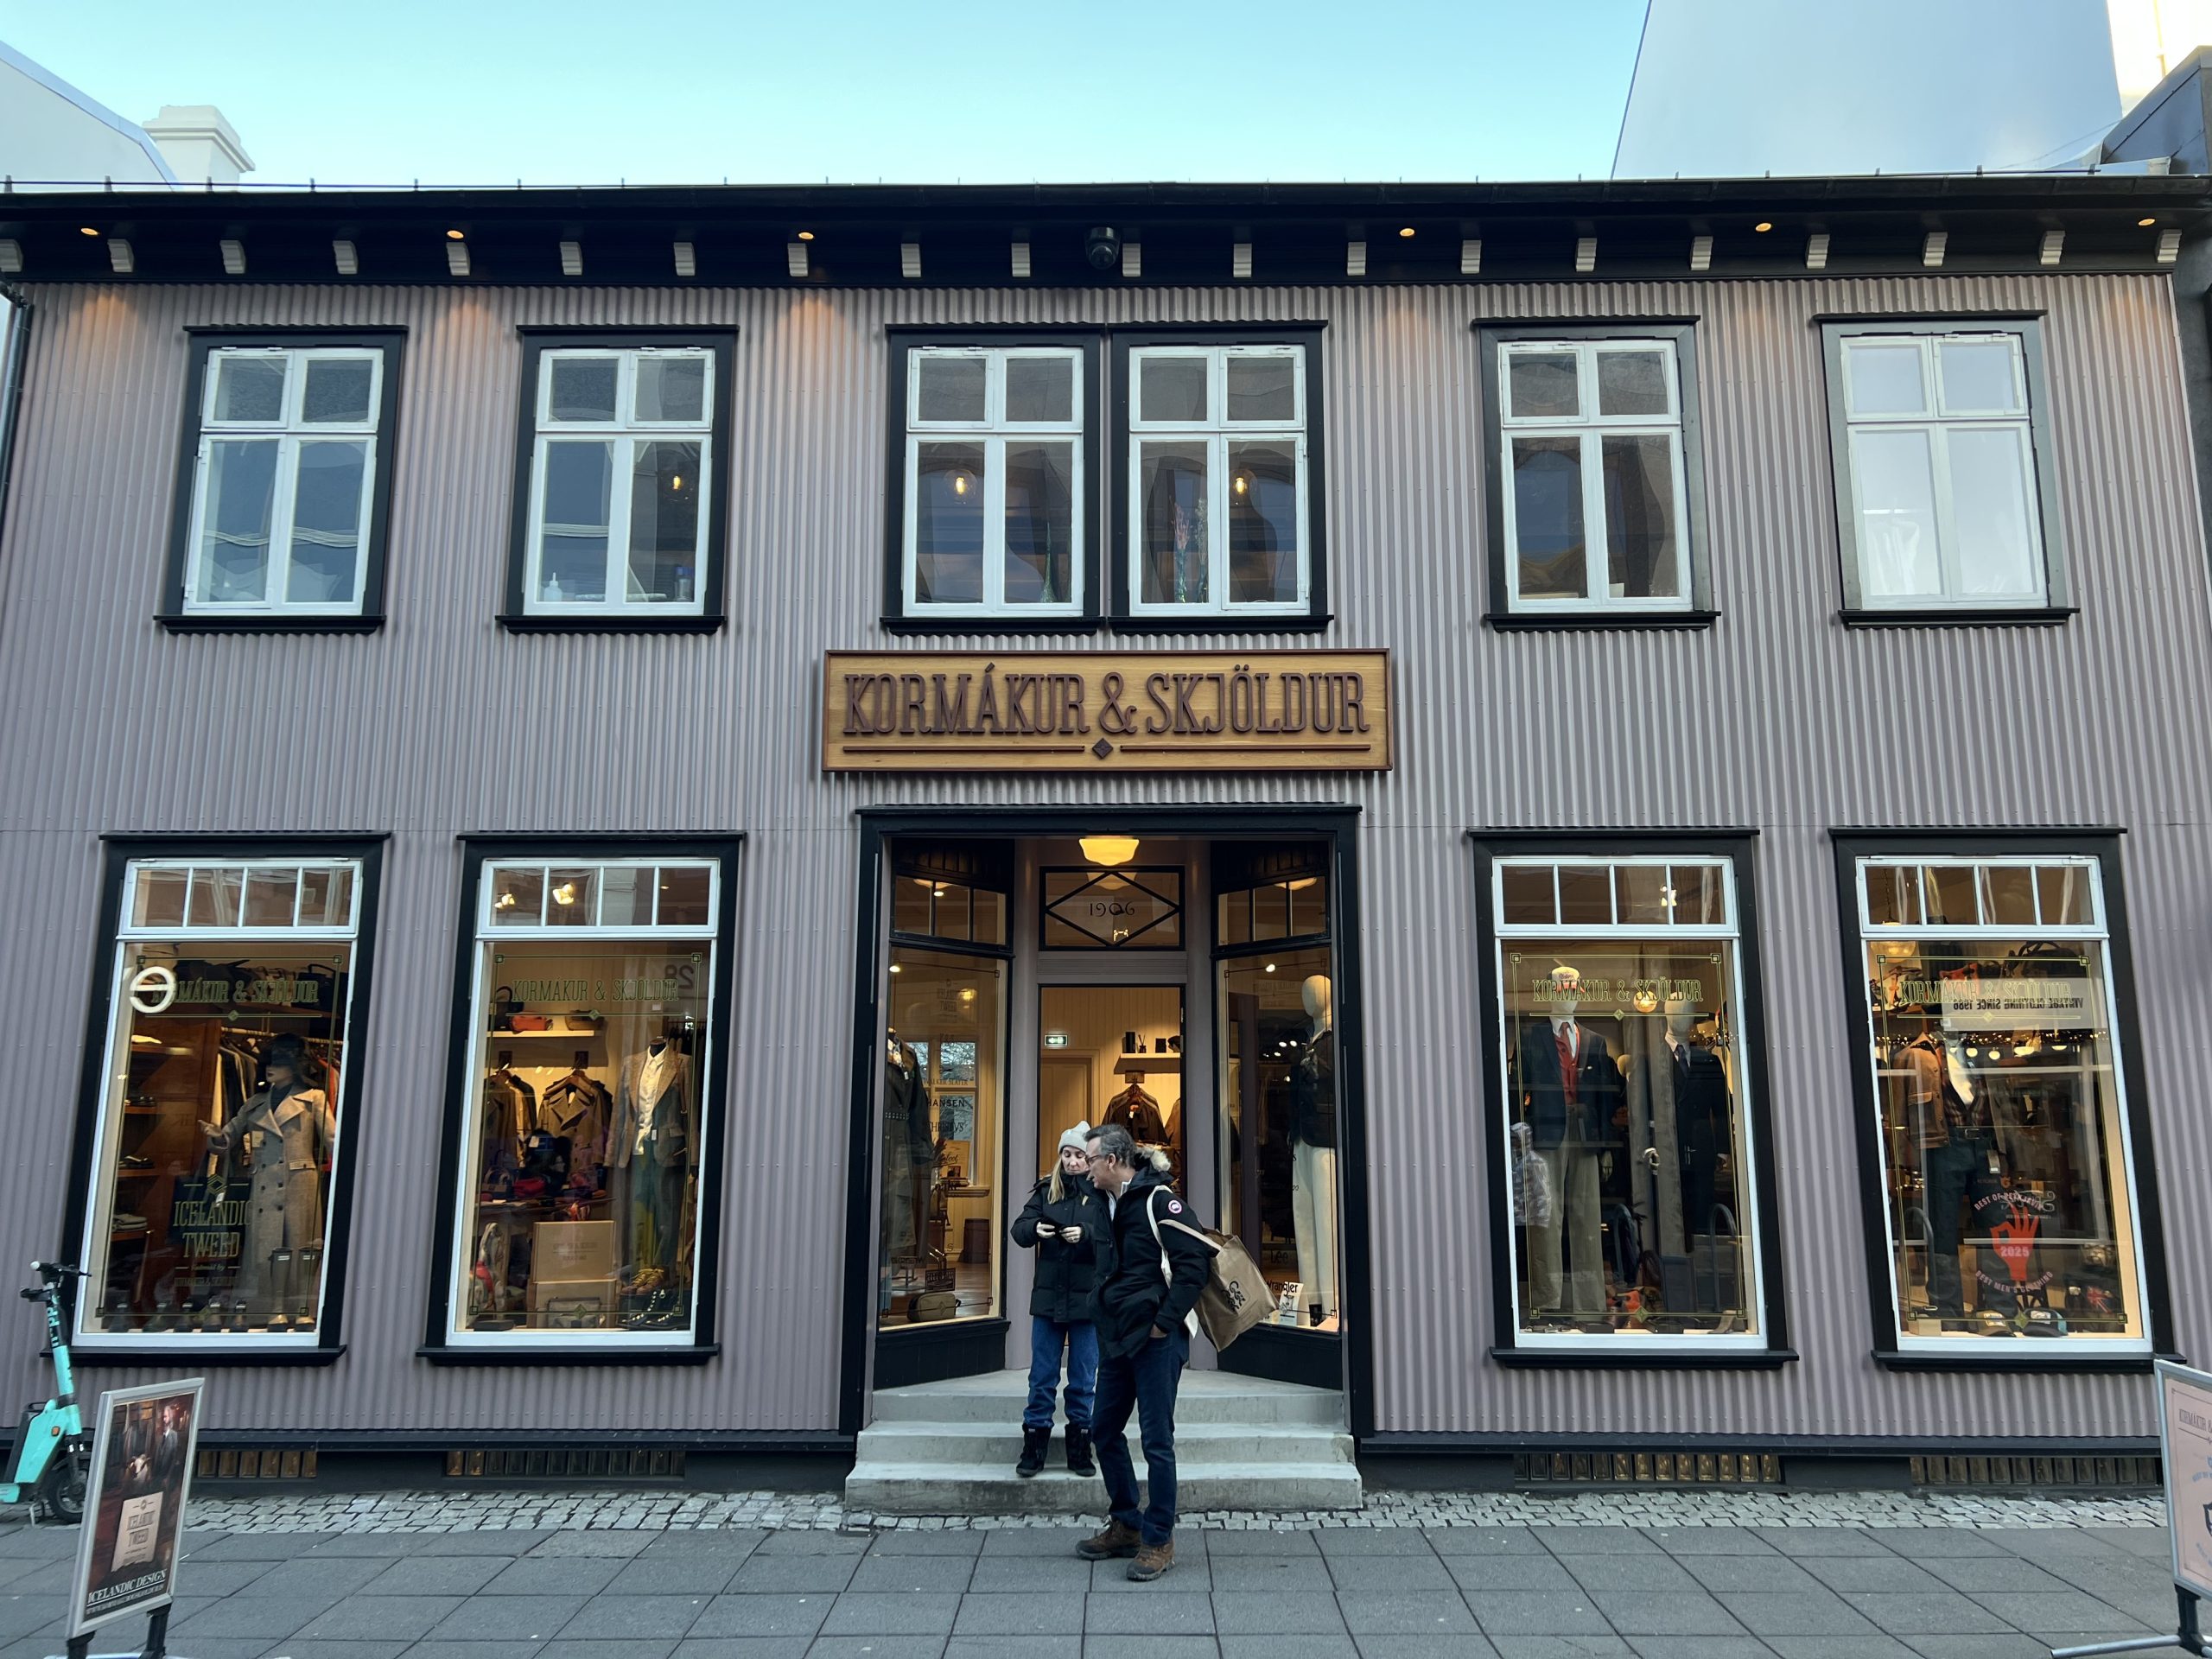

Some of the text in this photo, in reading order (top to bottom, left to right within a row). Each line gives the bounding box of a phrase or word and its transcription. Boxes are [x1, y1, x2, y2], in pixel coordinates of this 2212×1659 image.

[843, 662, 1370, 734] KORMÁKUR & SKJÖLDUR
[1090, 902, 1135, 917] 1906
[151, 976, 228, 1003] KMÁKUR
[233, 980, 247, 1003] &
[512, 976, 588, 1001] KORMÁKUR
[594, 980, 606, 1001] &
[1616, 979, 1630, 1002] &
[1635, 976, 1704, 1002] SKJÖLDUR
[1899, 977, 1978, 1003] KORMÁKUR
[1984, 980, 1999, 1003] &
[927, 1098, 965, 1108] HANSEN
[173, 1200, 253, 1226] ICELANDIC
[1974, 1196, 1992, 1211] BEST
[182, 1231, 239, 1258] TWEED
[1270, 1249, 1289, 1264] Lee
[2000, 1246, 2030, 1256] 2025
[1267, 1279, 1299, 1297] Wrangler
[1975, 1270, 1993, 1286] BEST
[1993, 1281, 2018, 1294] MEN'S
[88, 1578, 137, 1604] ICELANDIC
[136, 1568, 167, 1591] DESIGN
